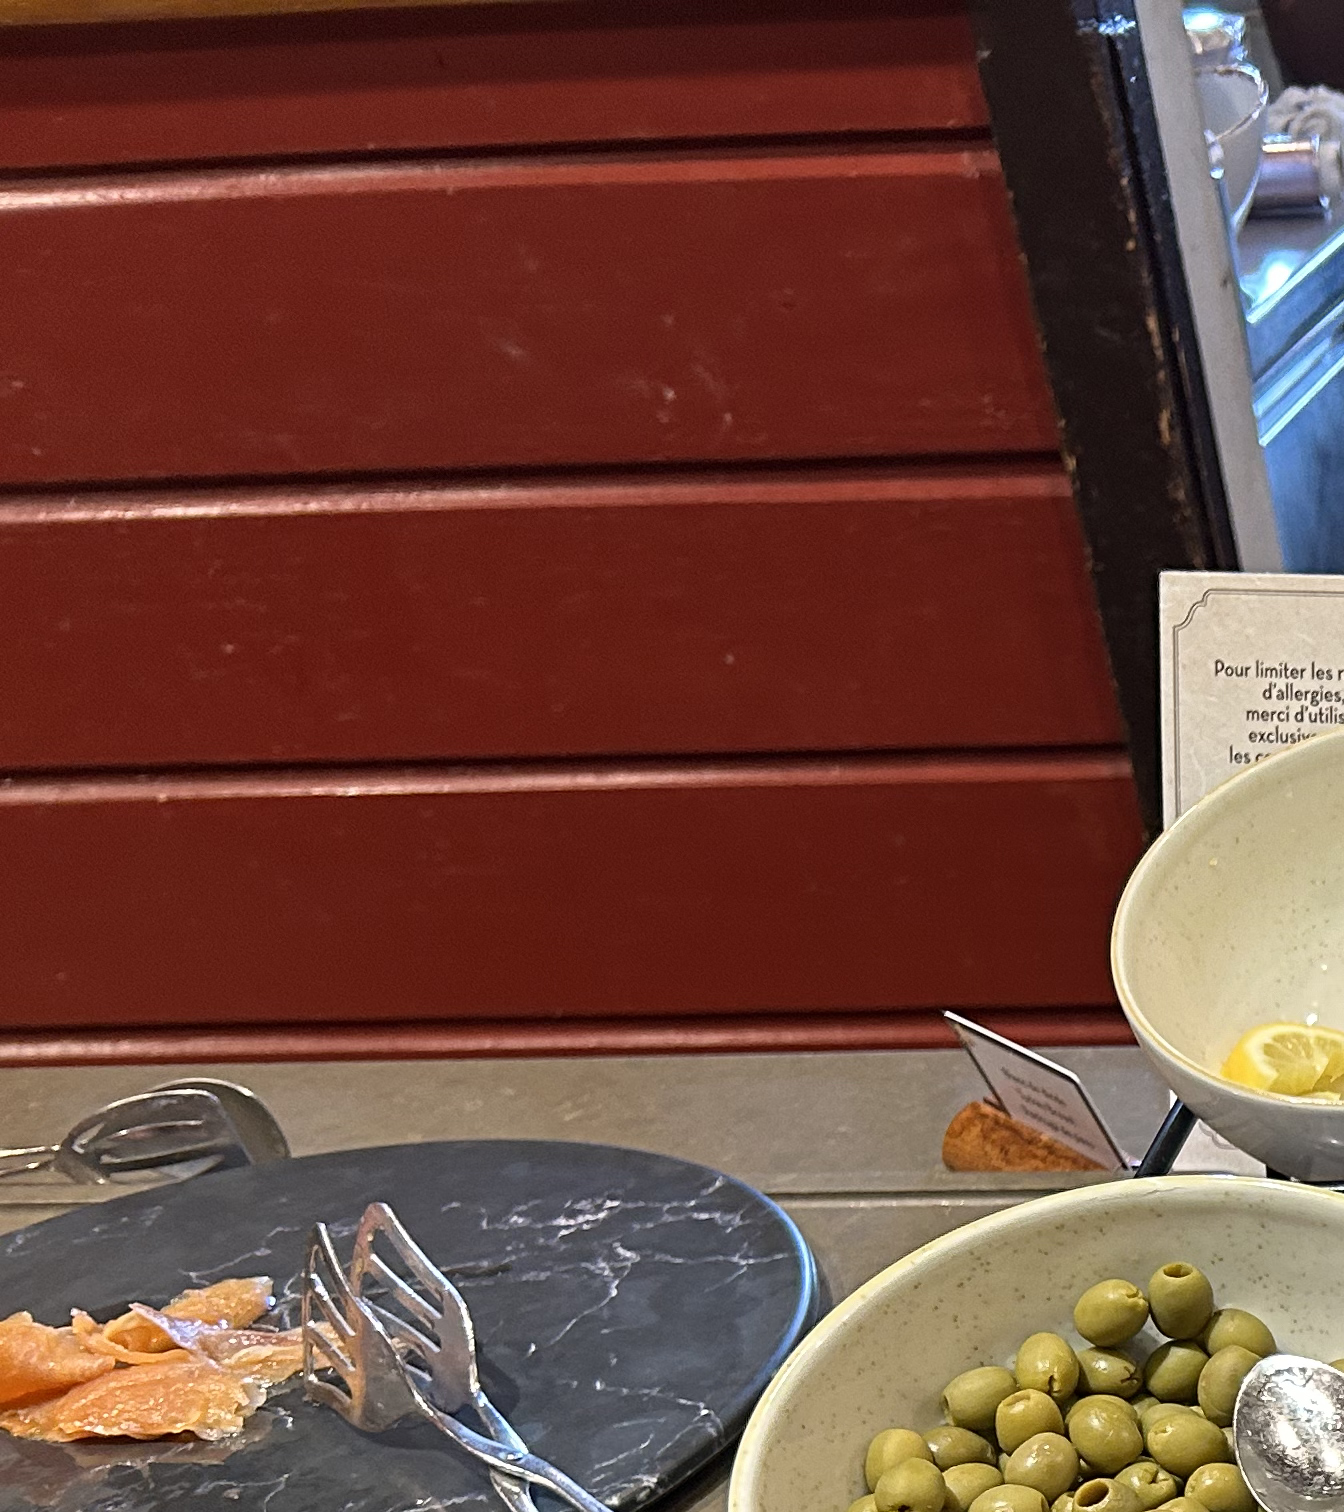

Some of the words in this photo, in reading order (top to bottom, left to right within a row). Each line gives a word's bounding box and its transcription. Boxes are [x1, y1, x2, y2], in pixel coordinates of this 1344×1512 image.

[1215, 659, 1251, 678] Pour
[1256, 660, 1306, 680] limiter
[1311, 662, 1333, 681] les
[1246, 705, 1290, 722] merci
[1229, 744, 1251, 764] les
